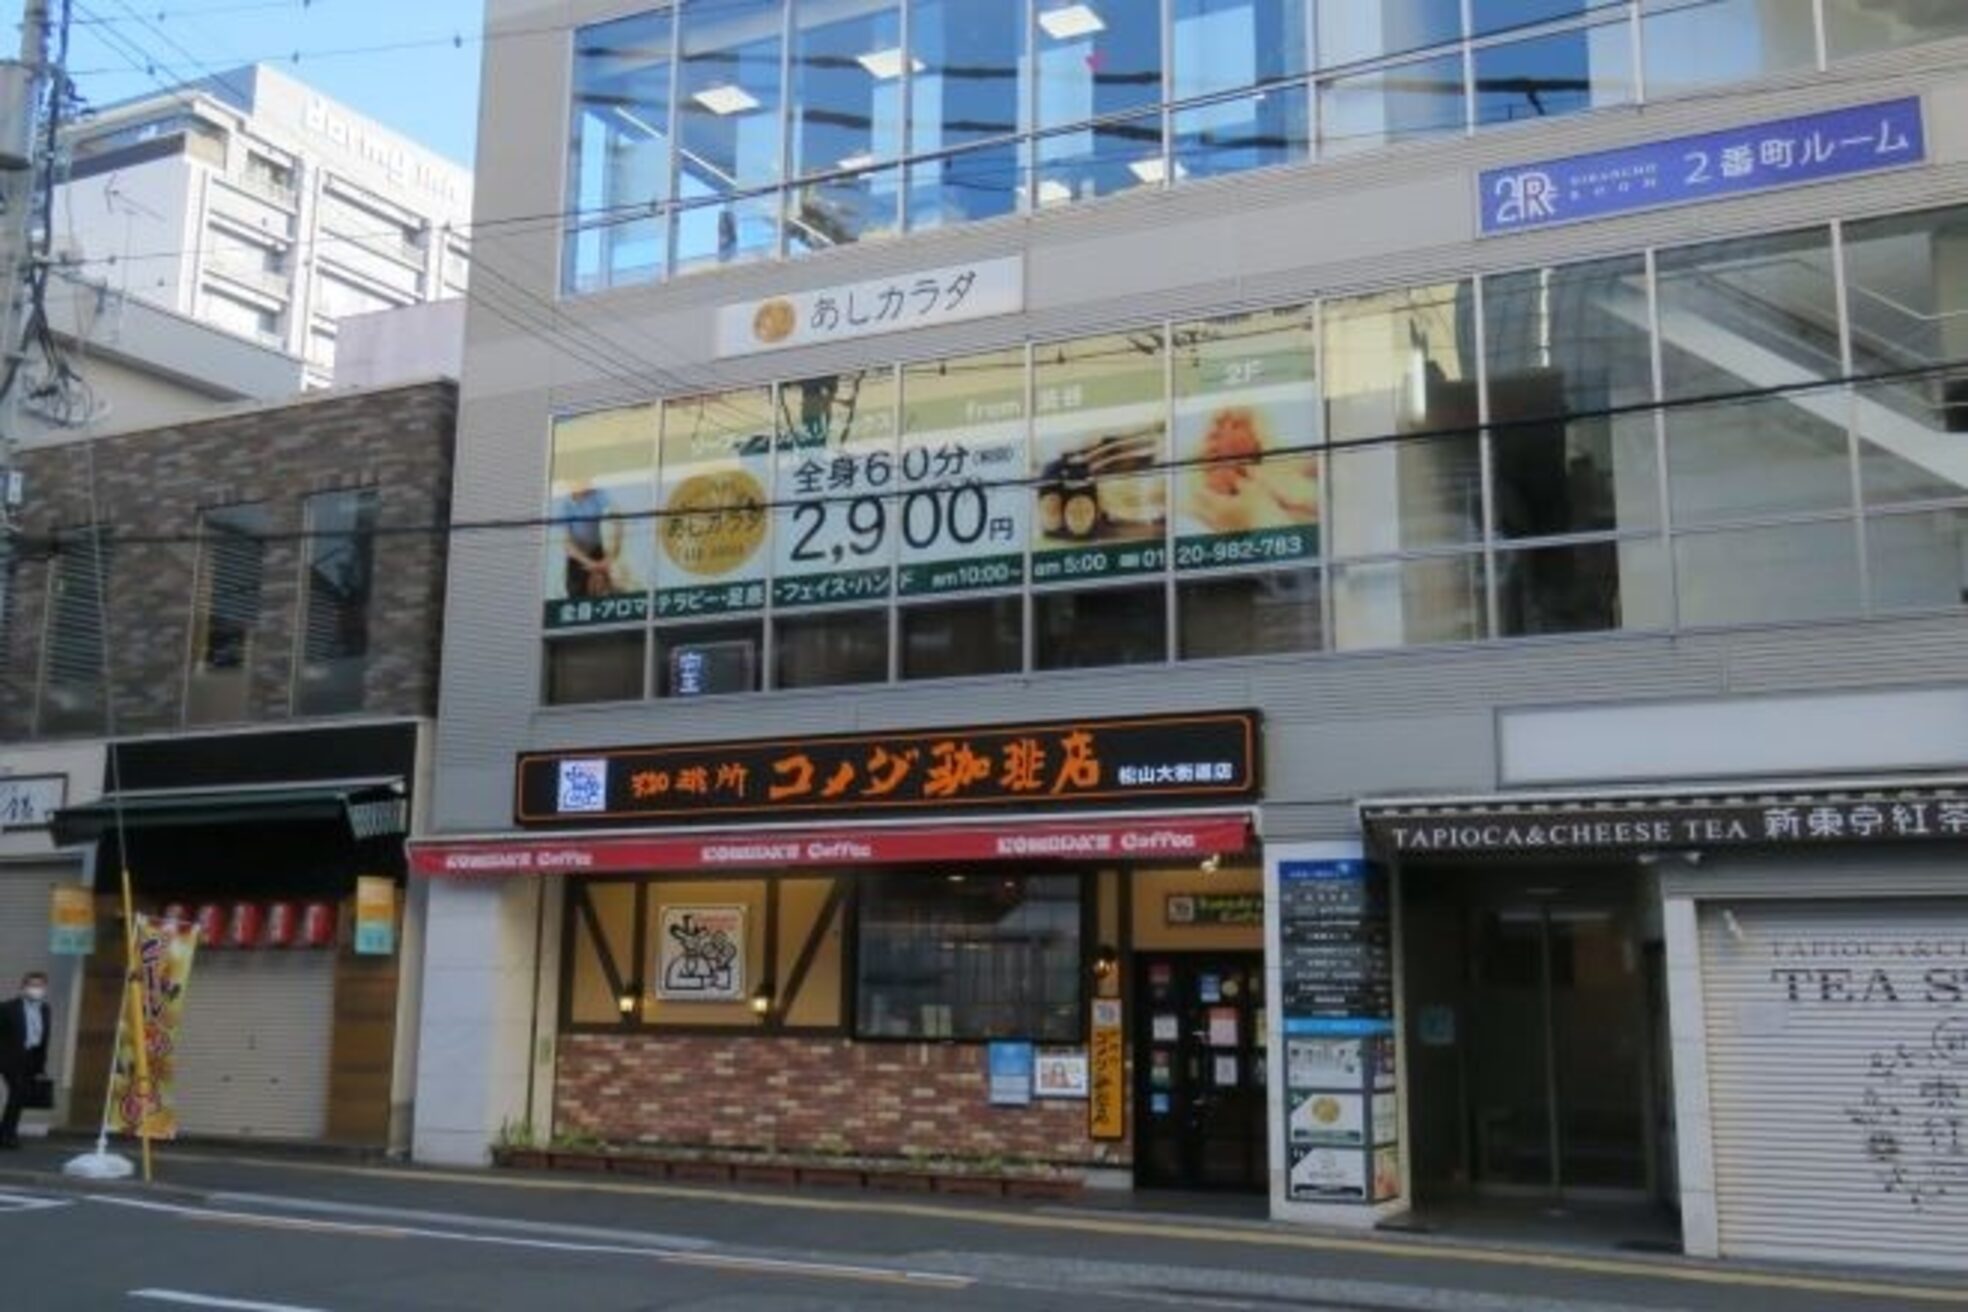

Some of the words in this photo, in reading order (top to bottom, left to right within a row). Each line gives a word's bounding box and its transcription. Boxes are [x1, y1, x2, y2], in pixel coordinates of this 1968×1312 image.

[810, 270, 976, 331] あしカラダ
[1392, 820, 1671, 849] TAPIOCA&CHEESE
[1683, 819, 1749, 840] TEA
[1770, 967, 1899, 1003] TEA
[1923, 967, 1968, 1003] S
